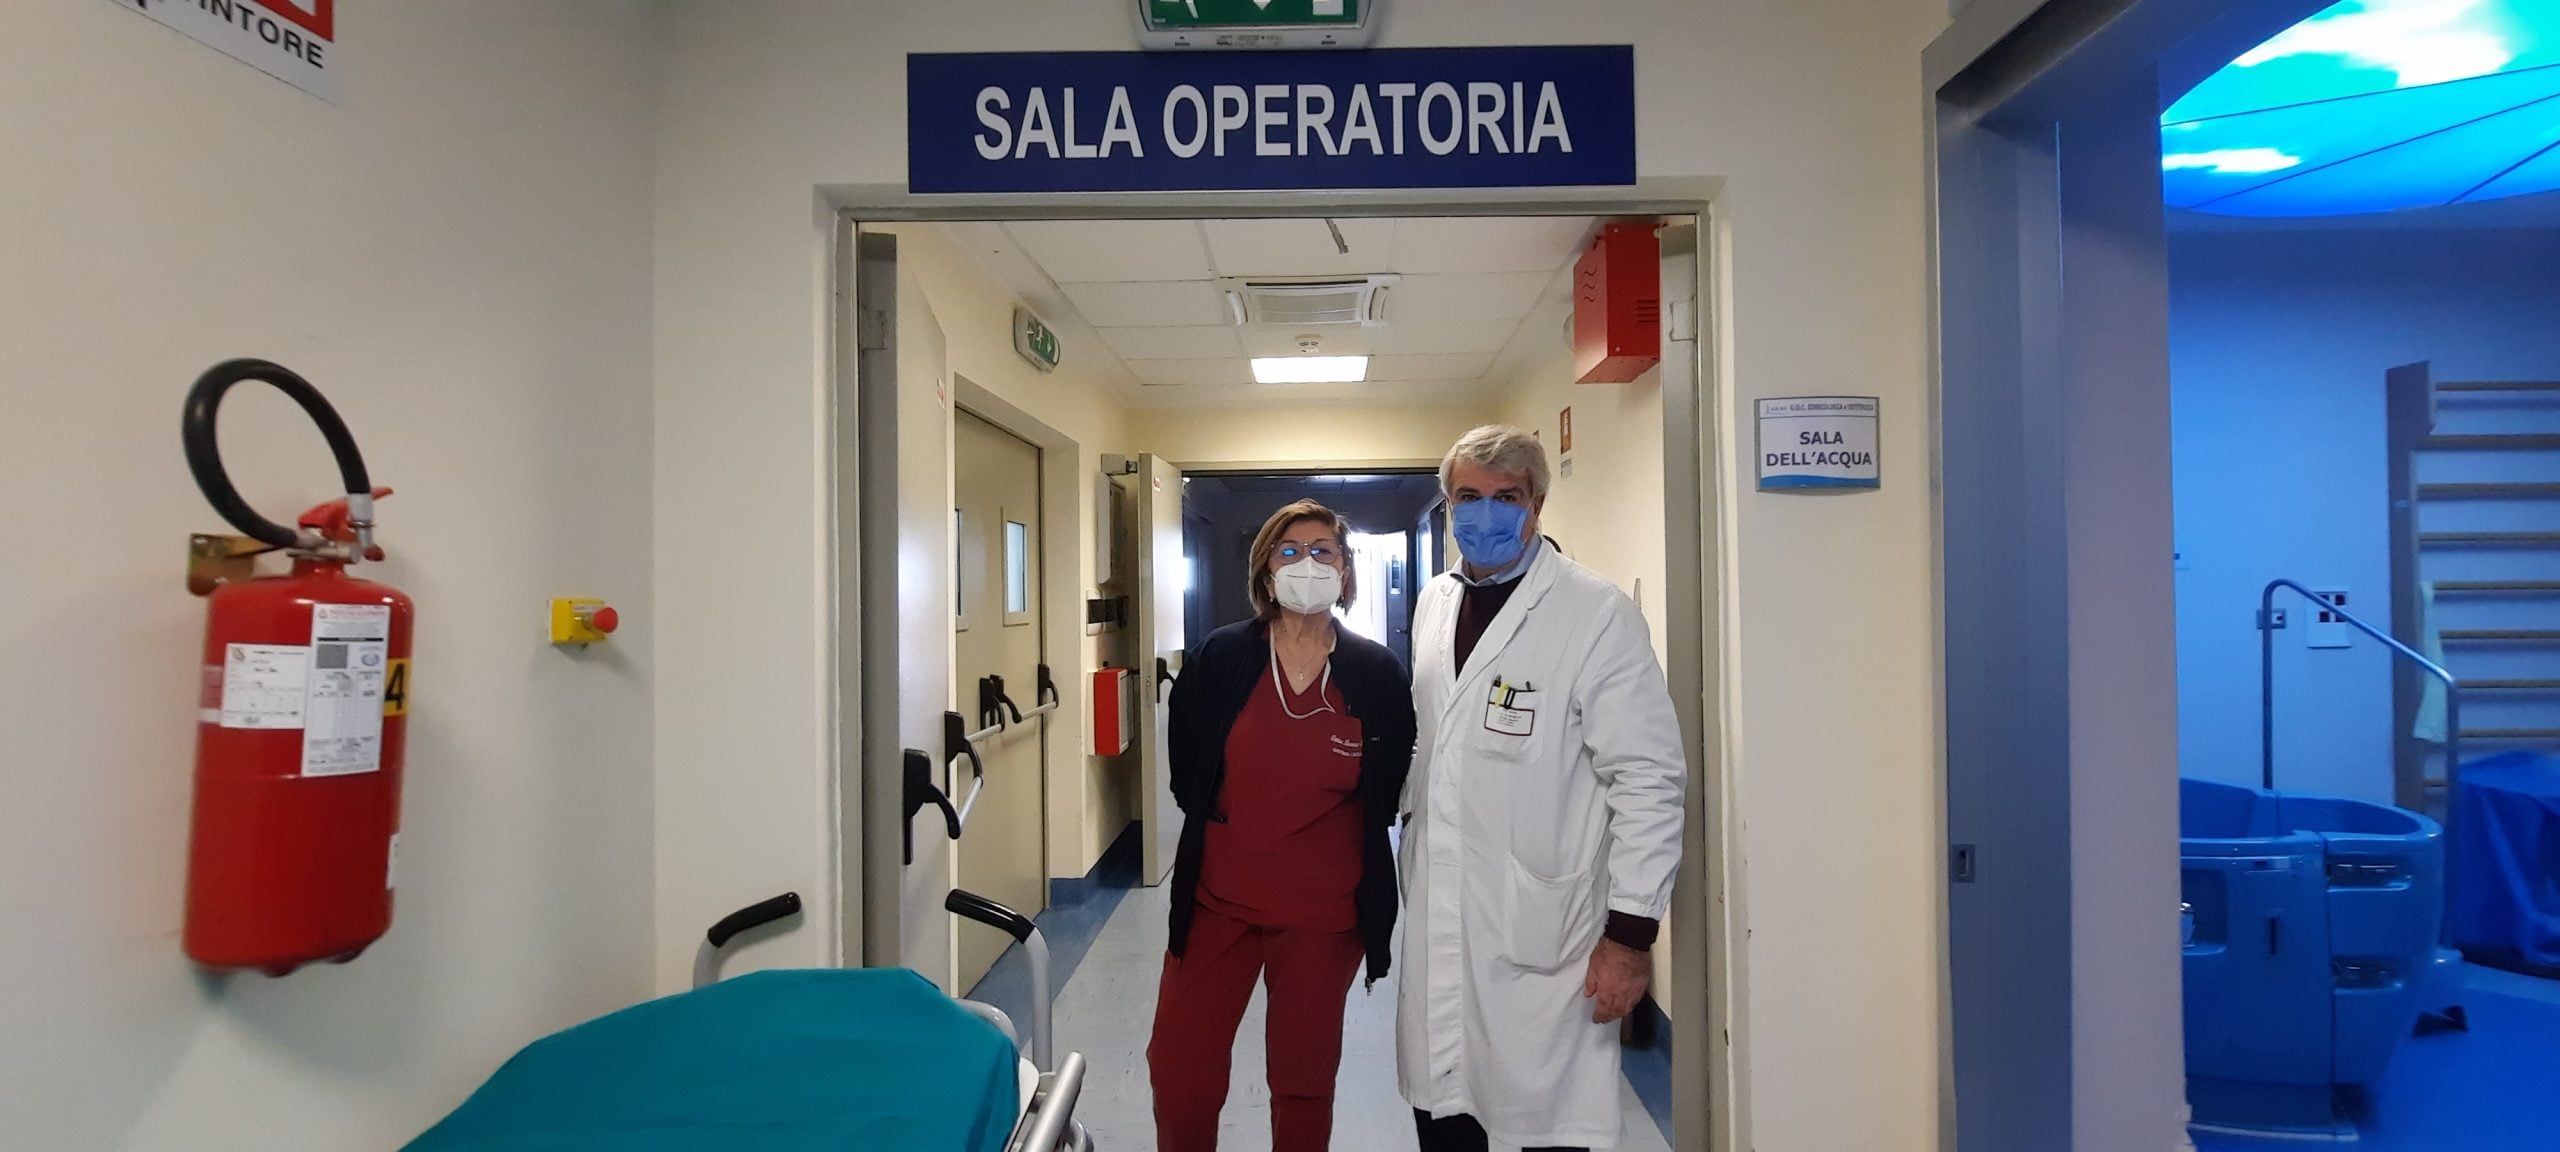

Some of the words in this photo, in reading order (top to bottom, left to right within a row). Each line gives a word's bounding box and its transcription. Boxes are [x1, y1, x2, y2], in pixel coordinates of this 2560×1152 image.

[974, 86, 1144, 160] SALA
[1163, 81, 1573, 158] OPERATORIA
[1799, 431, 1844, 445] SALA
[1766, 451, 1873, 469] DELL'ACQUA
[384, 663, 405, 711] 4
